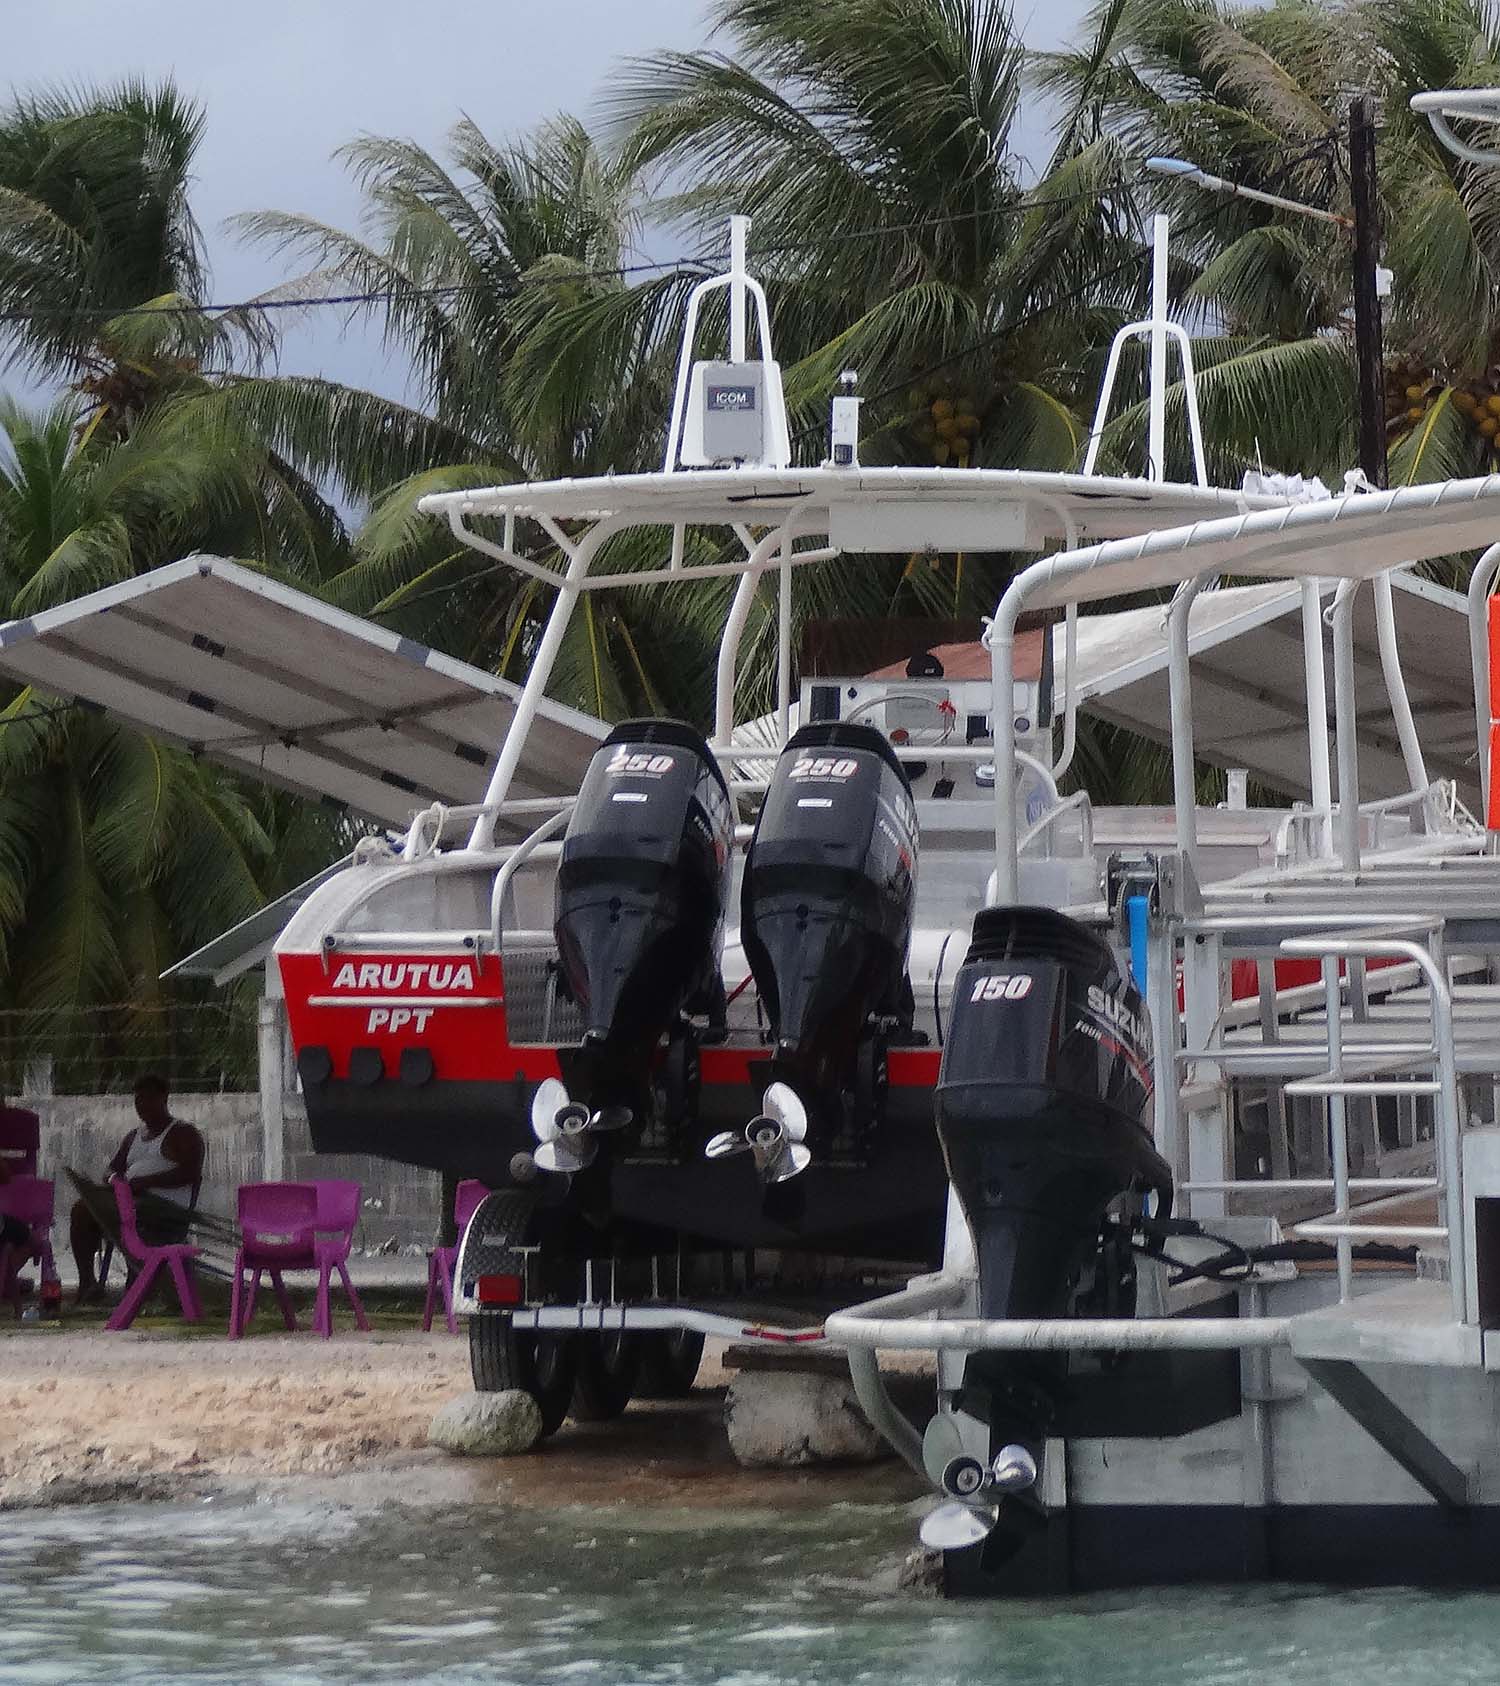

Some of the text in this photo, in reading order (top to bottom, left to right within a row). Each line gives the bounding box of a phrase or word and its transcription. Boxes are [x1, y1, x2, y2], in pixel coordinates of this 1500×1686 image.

[716, 391, 747, 404] ICOM
[605, 752, 676, 773] 250
[788, 757, 859, 778] 250
[332, 963, 474, 990] ARUTUA
[970, 974, 1033, 1003] 150
[367, 1008, 435, 1034] PPT
